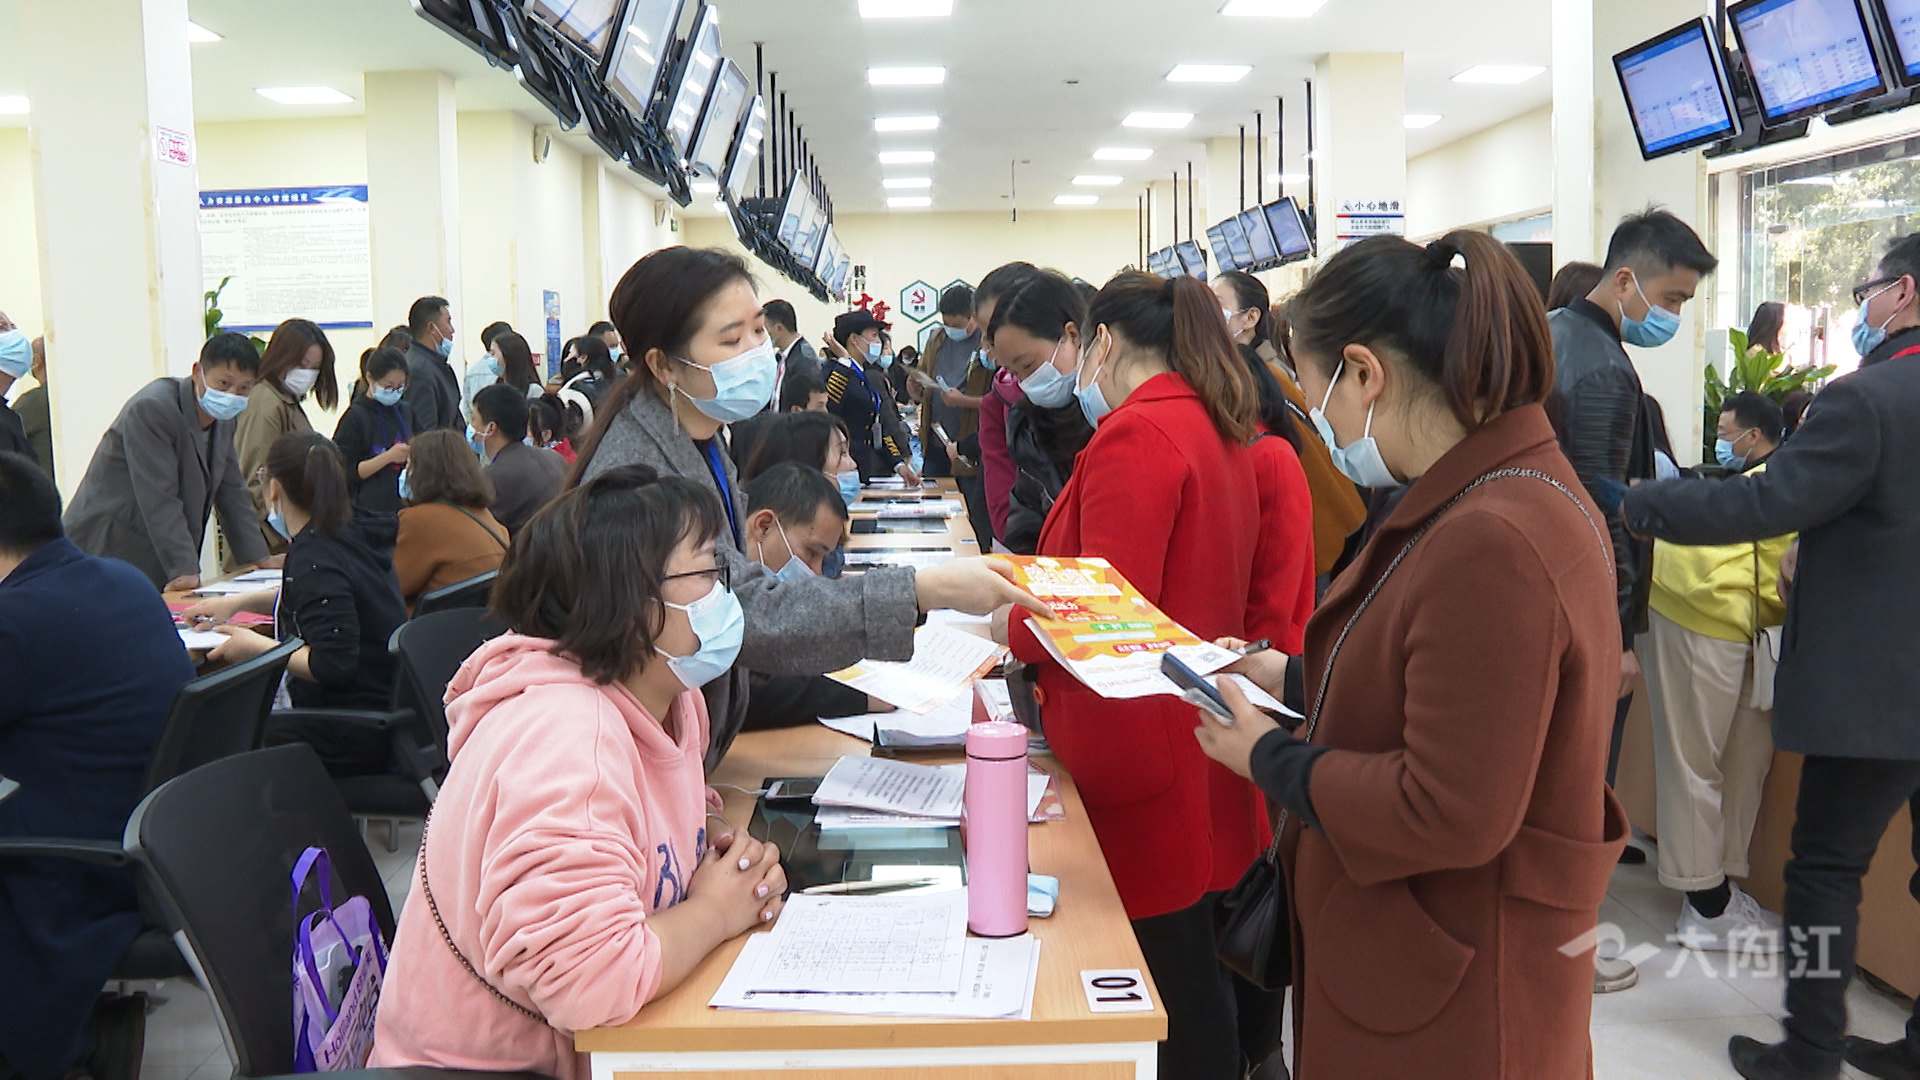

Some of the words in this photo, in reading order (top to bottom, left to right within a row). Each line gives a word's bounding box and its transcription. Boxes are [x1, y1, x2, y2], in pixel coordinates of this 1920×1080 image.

[1355, 200, 1399, 211] 小心地滑
[1091, 976, 1143, 1002] 01
